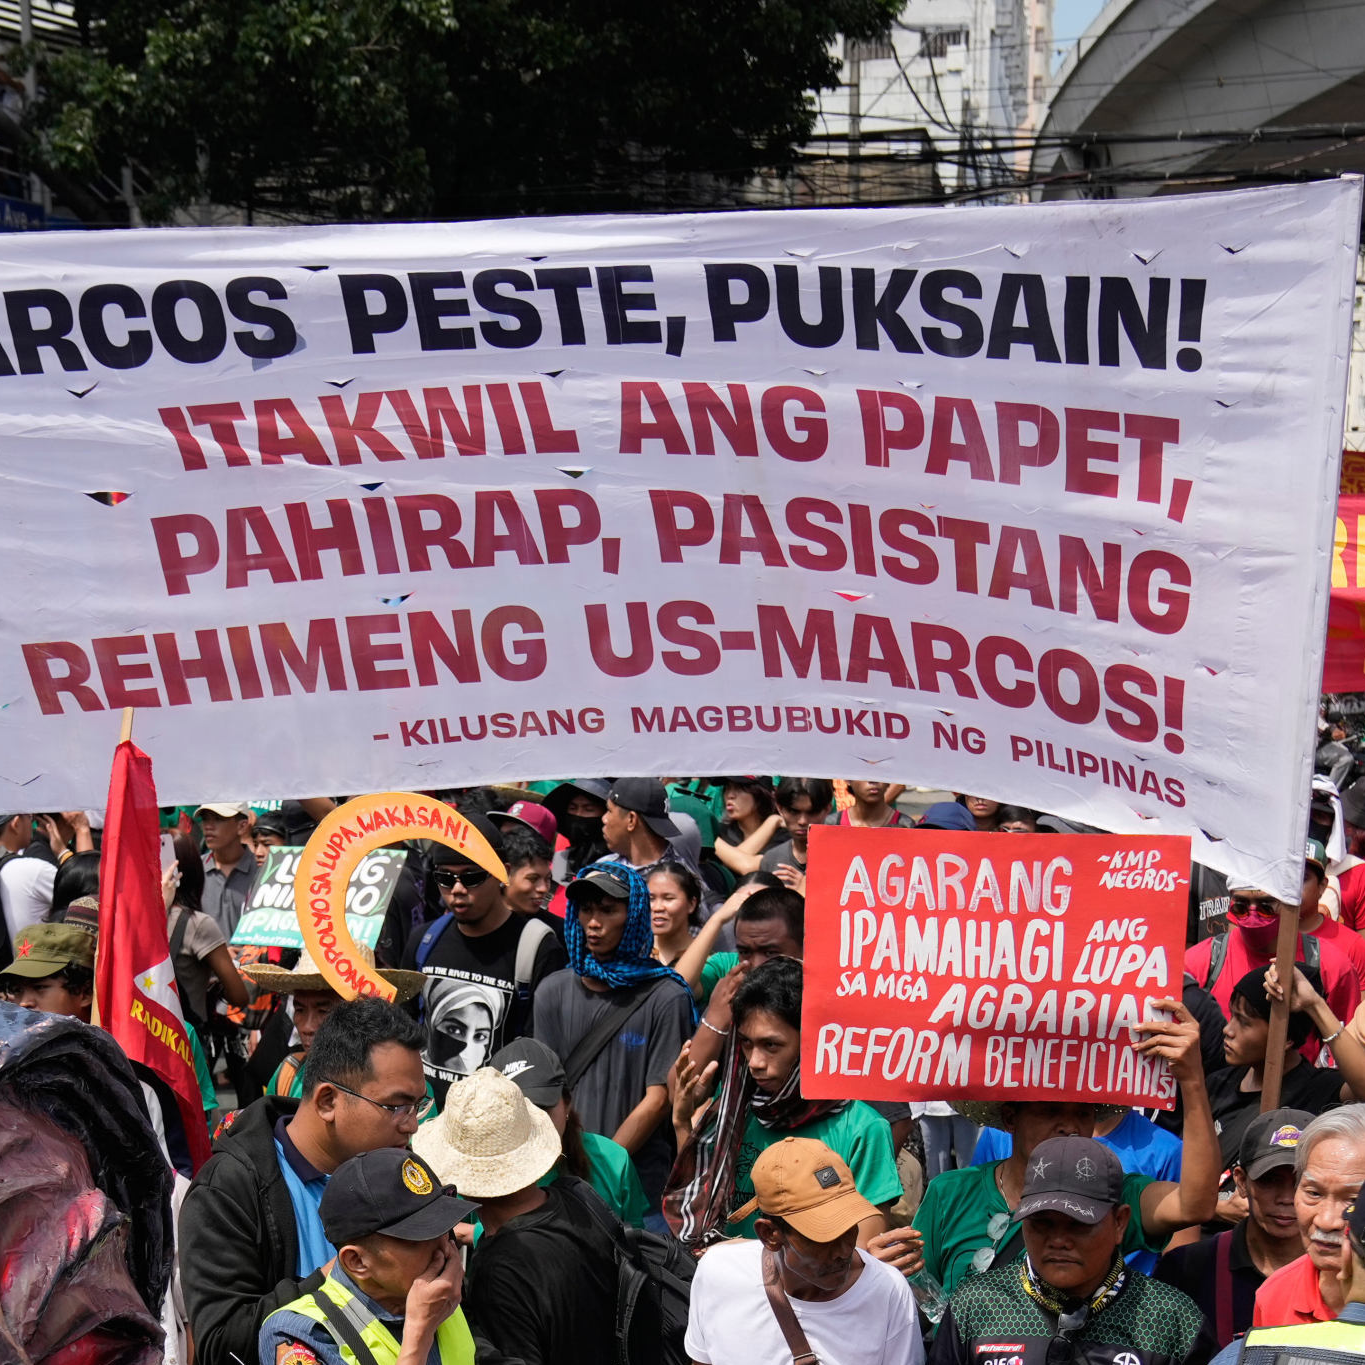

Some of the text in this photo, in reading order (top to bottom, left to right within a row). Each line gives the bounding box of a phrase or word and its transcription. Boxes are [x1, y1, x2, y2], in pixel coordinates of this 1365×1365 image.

[339, 266, 687, 358] PESTE,
[704, 263, 1207, 373] PUKSAIN!
[158, 381, 1193, 522] ITAKWIL ANG PAPET,
[150, 488, 1191, 635] PAHIRAP, PASISTANG
[21, 600, 1185, 756] REHIMENG US-MARCOS!
[399, 706, 606, 748] KILUSANG
[632, 704, 910, 740] MAGBUBUKID
[932, 720, 986, 755] NG
[1010, 734, 1186, 808] PILIPINAS
[310, 872, 332, 896] SA
[356, 805, 470, 849] WAKASAN!
[839, 852, 1073, 917] AGARANG
[434, 966, 448, 975] THE
[447, 968, 470, 980] RIVER
[471, 972, 482, 982] TO
[483, 973, 496, 986] THE
[837, 909, 1148, 985] IPAMAHAGI ANG
[1072, 945, 1169, 988] LUPA
[836, 972, 868, 998] SA
[873, 975, 929, 1003] MGA
[439, 1068, 459, 1083] WILL
[505, 1060, 528, 1074] NIKE
[814, 1024, 971, 1088] REFORM
